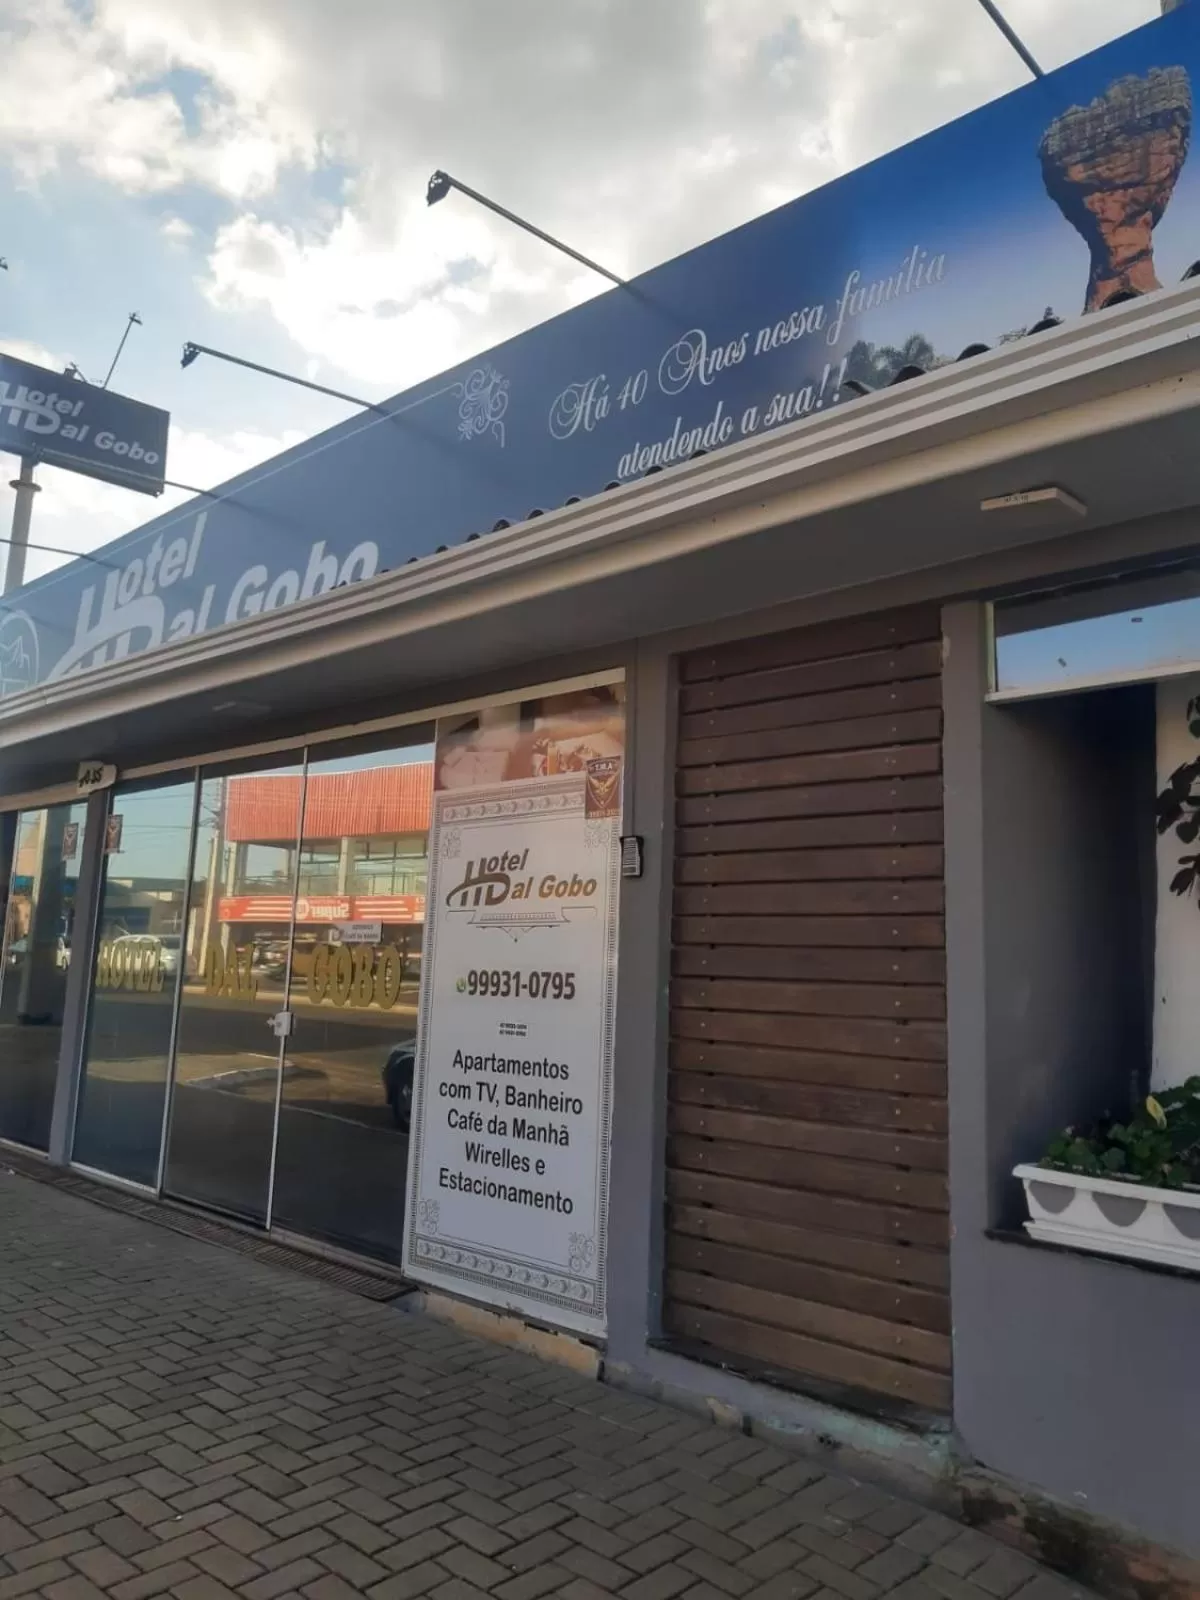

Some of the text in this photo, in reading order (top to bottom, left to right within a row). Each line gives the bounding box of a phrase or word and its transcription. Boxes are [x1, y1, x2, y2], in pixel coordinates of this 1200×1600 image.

[549, 245, 947, 439] Há 40 Anos nossa família
[0, 380, 85, 427] Hotel
[94, 430, 160, 465] Gobo
[617, 401, 734, 479] atendendo
[740, 408, 760, 434] a
[47, 512, 207, 682] Hotel
[225, 540, 379, 625] Gobo
[445, 848, 530, 907] Hotel
[538, 873, 597, 899] Gobo
[96, 939, 401, 1009] HOTEL DAL GOBO
[467, 969, 576, 1000] 99931-0795
[452, 1049, 569, 1080] Apartamentos
[439, 1081, 583, 1115] com TV, Banheiro
[447, 1108, 569, 1146] Café da Manhã
[464, 1141, 546, 1175] Wirelles e
[439, 1167, 574, 1215] Estacionamento
